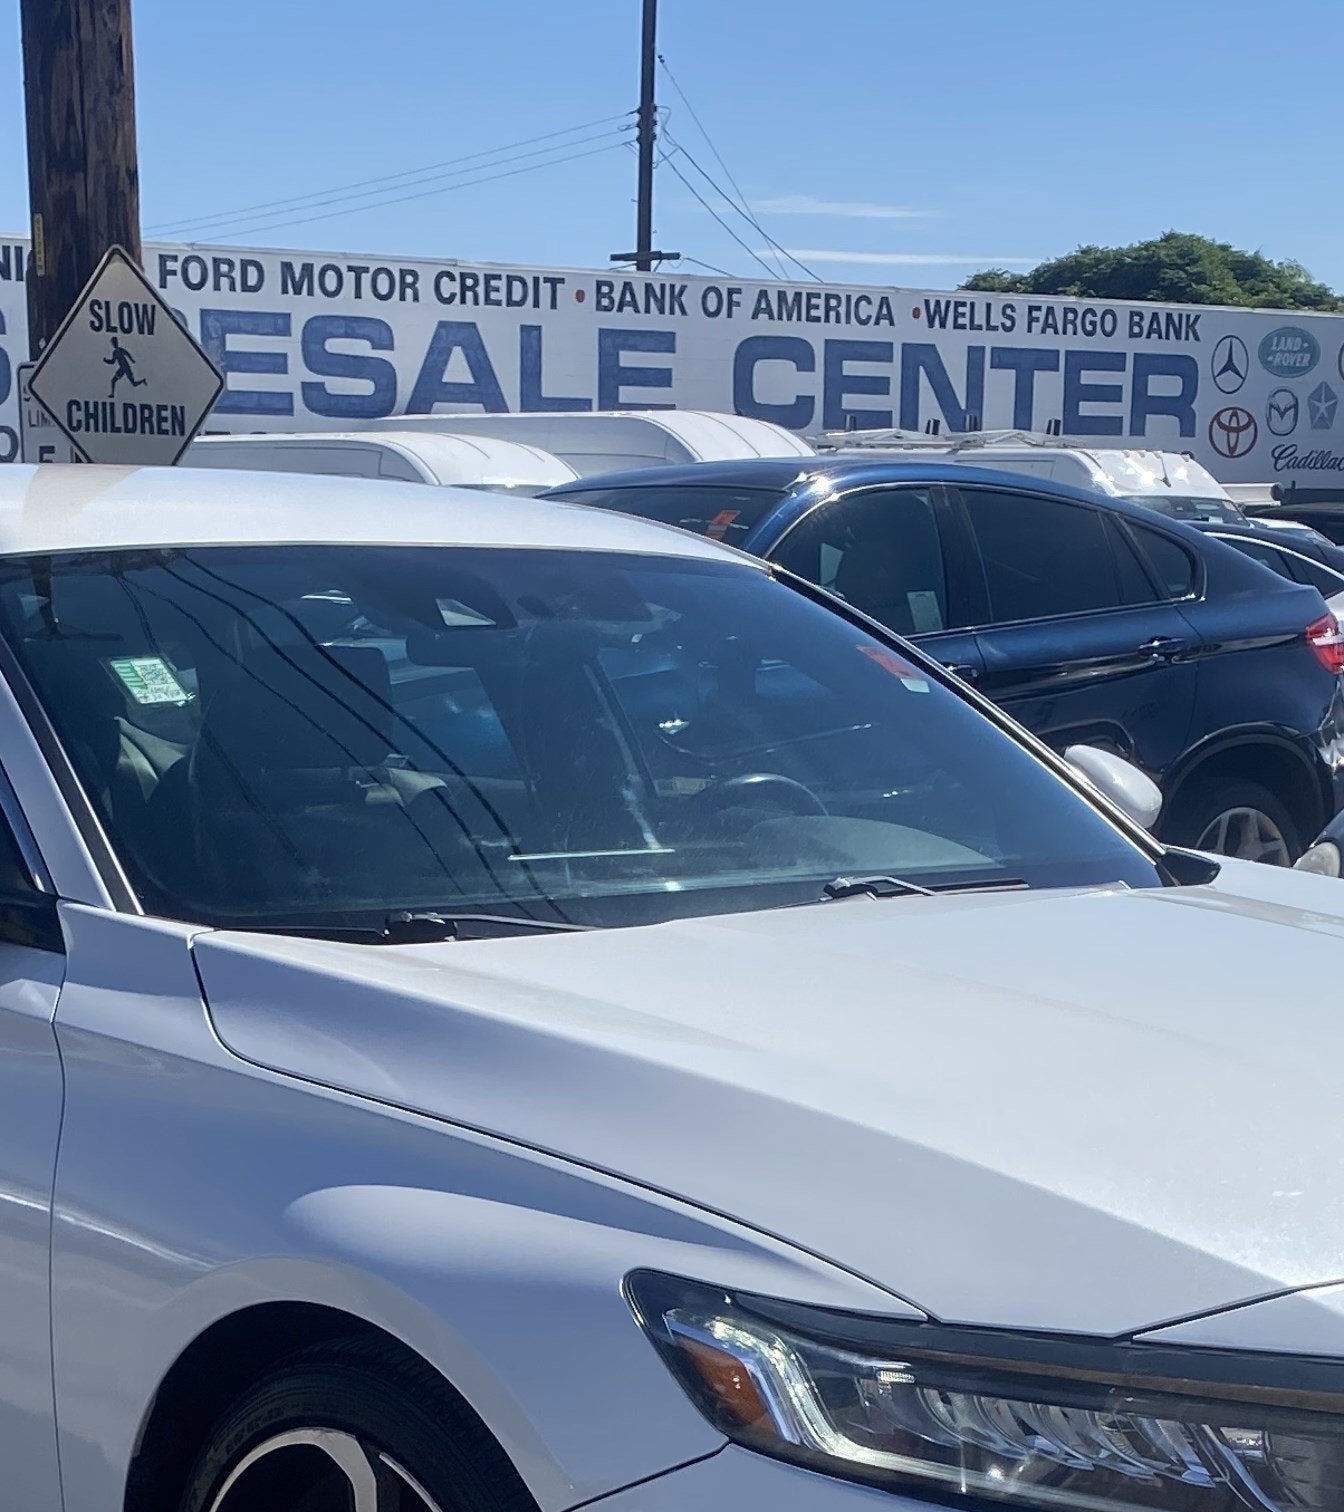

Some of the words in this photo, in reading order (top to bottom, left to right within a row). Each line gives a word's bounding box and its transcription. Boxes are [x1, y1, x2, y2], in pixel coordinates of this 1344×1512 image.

[88, 298, 156, 336] SLOW
[157, 253, 265, 293] FORD
[280, 260, 420, 303] MOTOR
[433, 271, 566, 310] CREDIT
[595, 280, 688, 317] BANK
[700, 285, 742, 319] OF
[751, 289, 896, 327] AMERICA
[923, 298, 1017, 333] WELLS
[1026, 305, 1118, 338] FARGO
[1127, 310, 1203, 342] BANK
[173, 307, 677, 419] ESALE
[732, 334, 1200, 439] CENTER
[65, 398, 186, 437] CHILDREN
